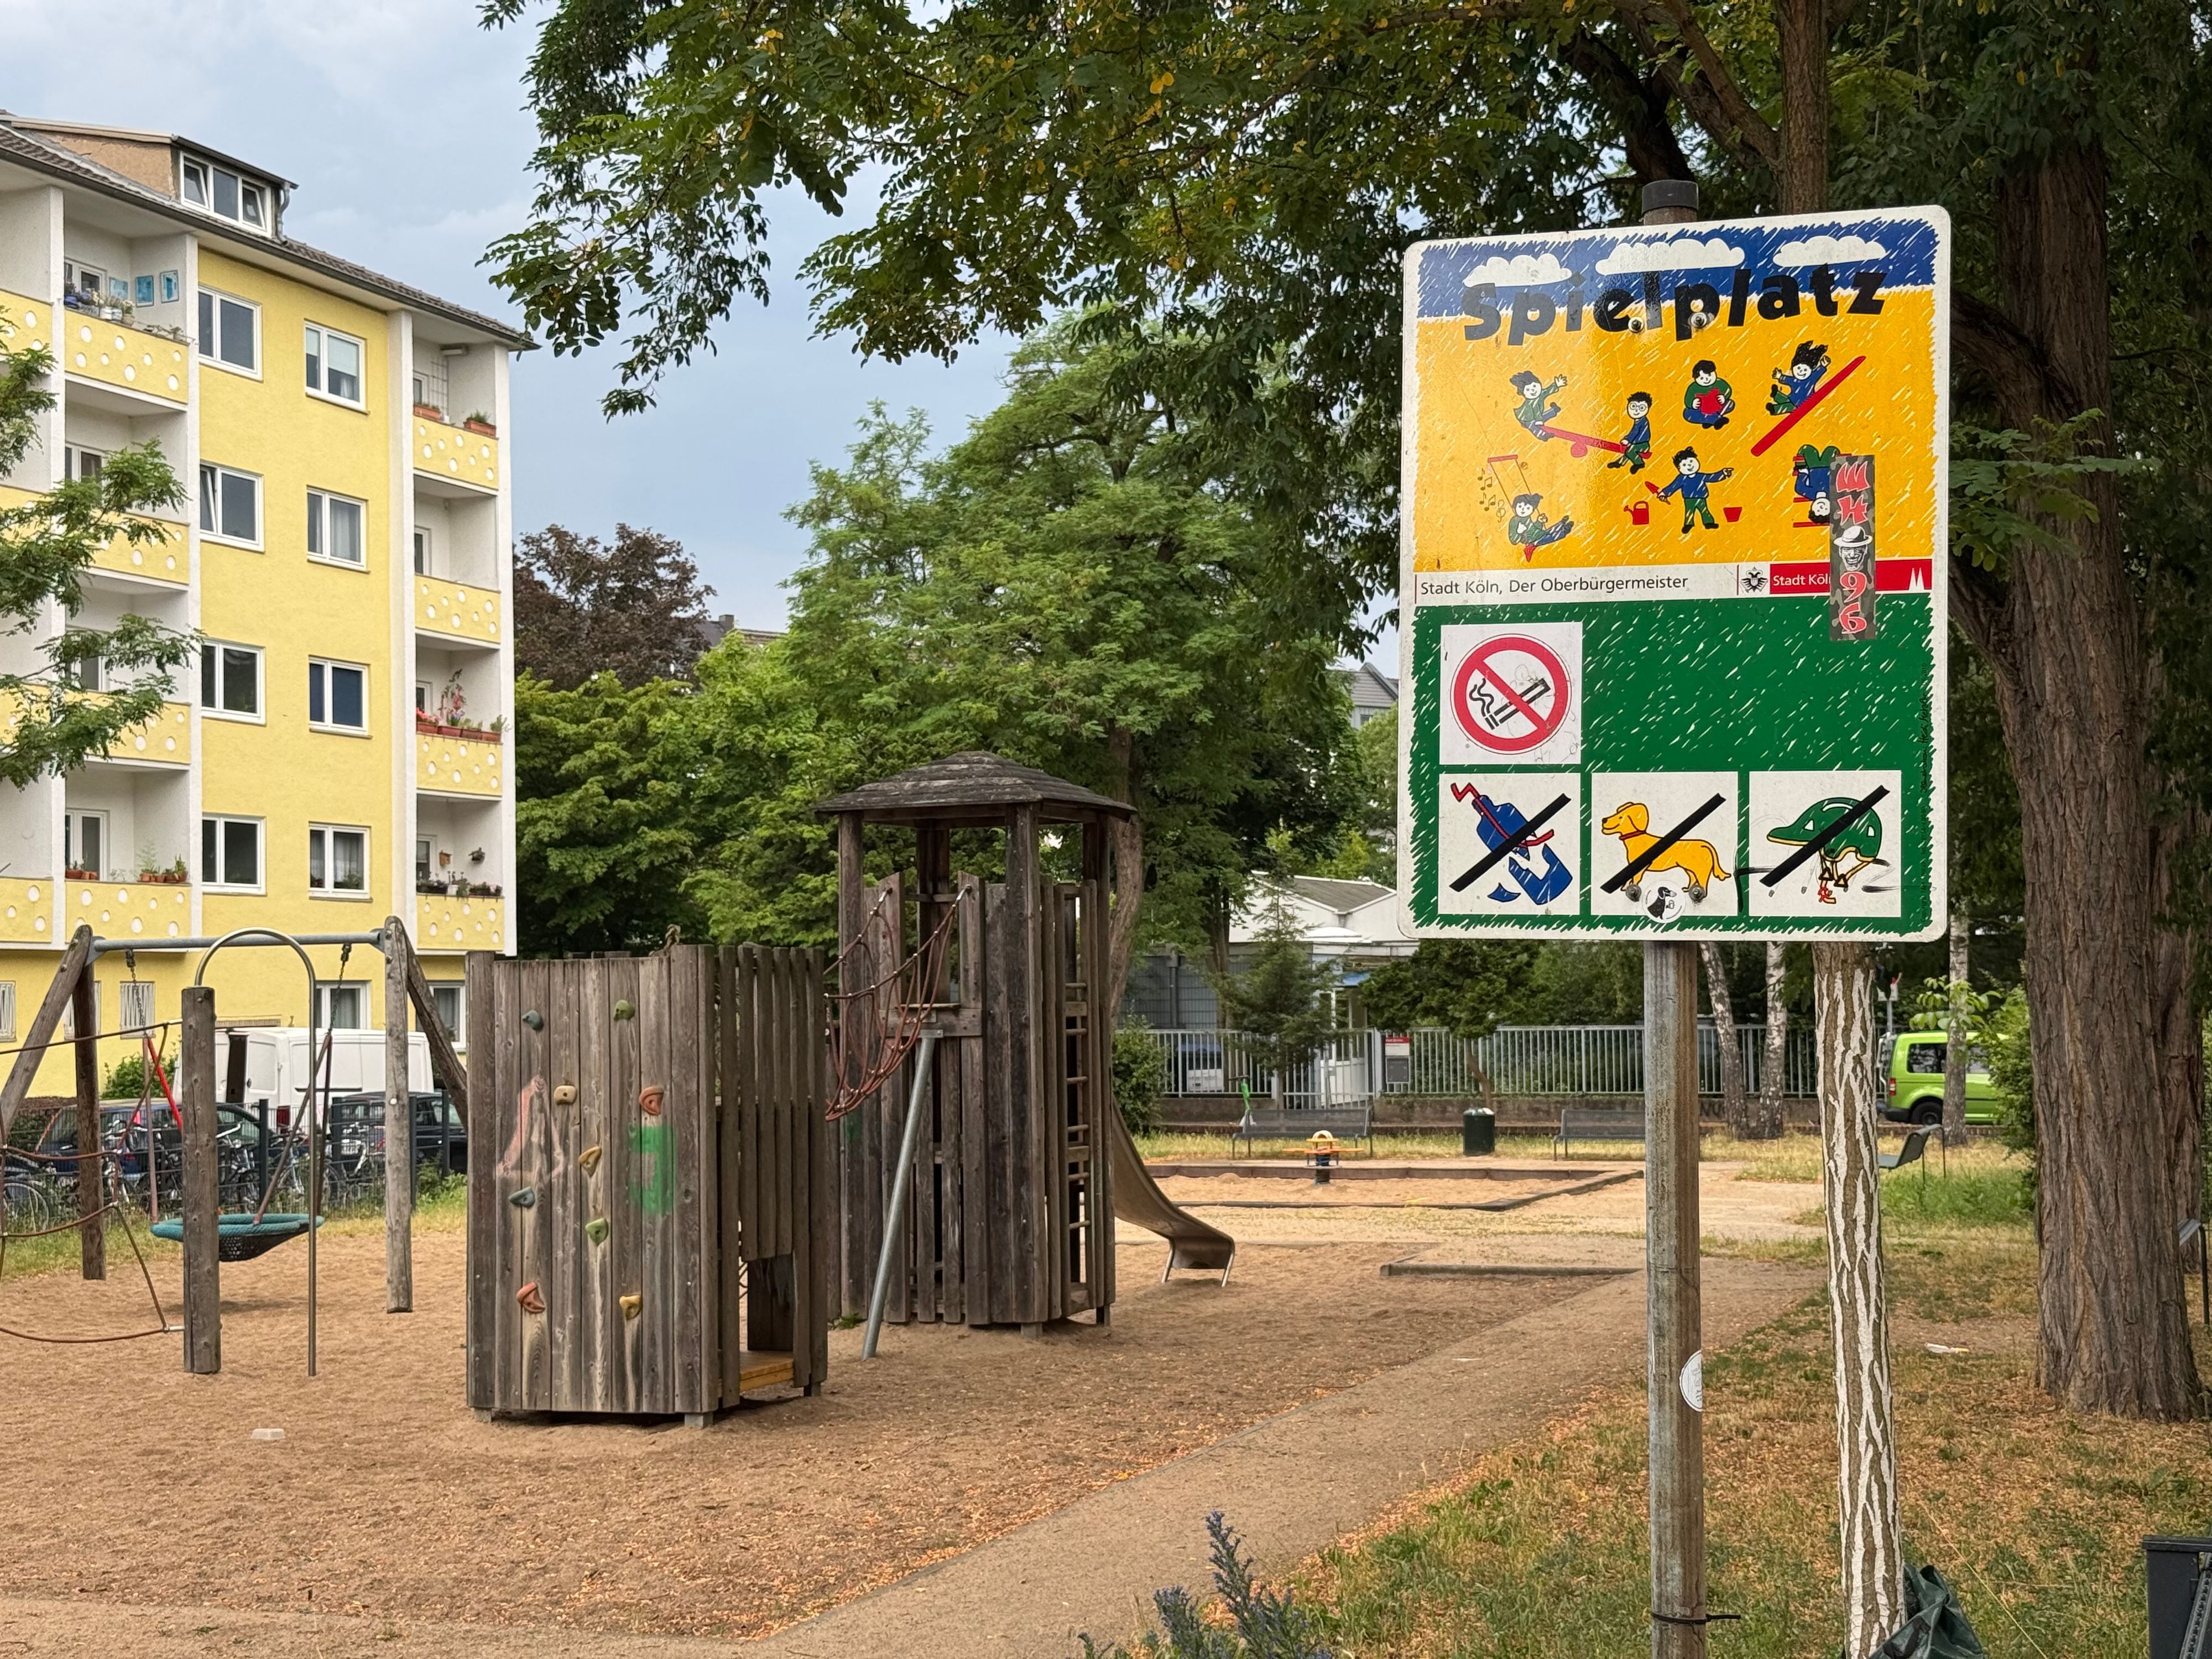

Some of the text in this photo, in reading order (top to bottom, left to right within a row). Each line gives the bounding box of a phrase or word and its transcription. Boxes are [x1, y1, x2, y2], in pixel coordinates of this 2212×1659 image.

[1460, 264, 1887, 345] Spielplatz
[1420, 575, 1689, 595] Stadt Köln, Der Oberbürgermeister
[1773, 573, 1831, 586] Stadt Köl
[1839, 571, 1867, 634] 96
